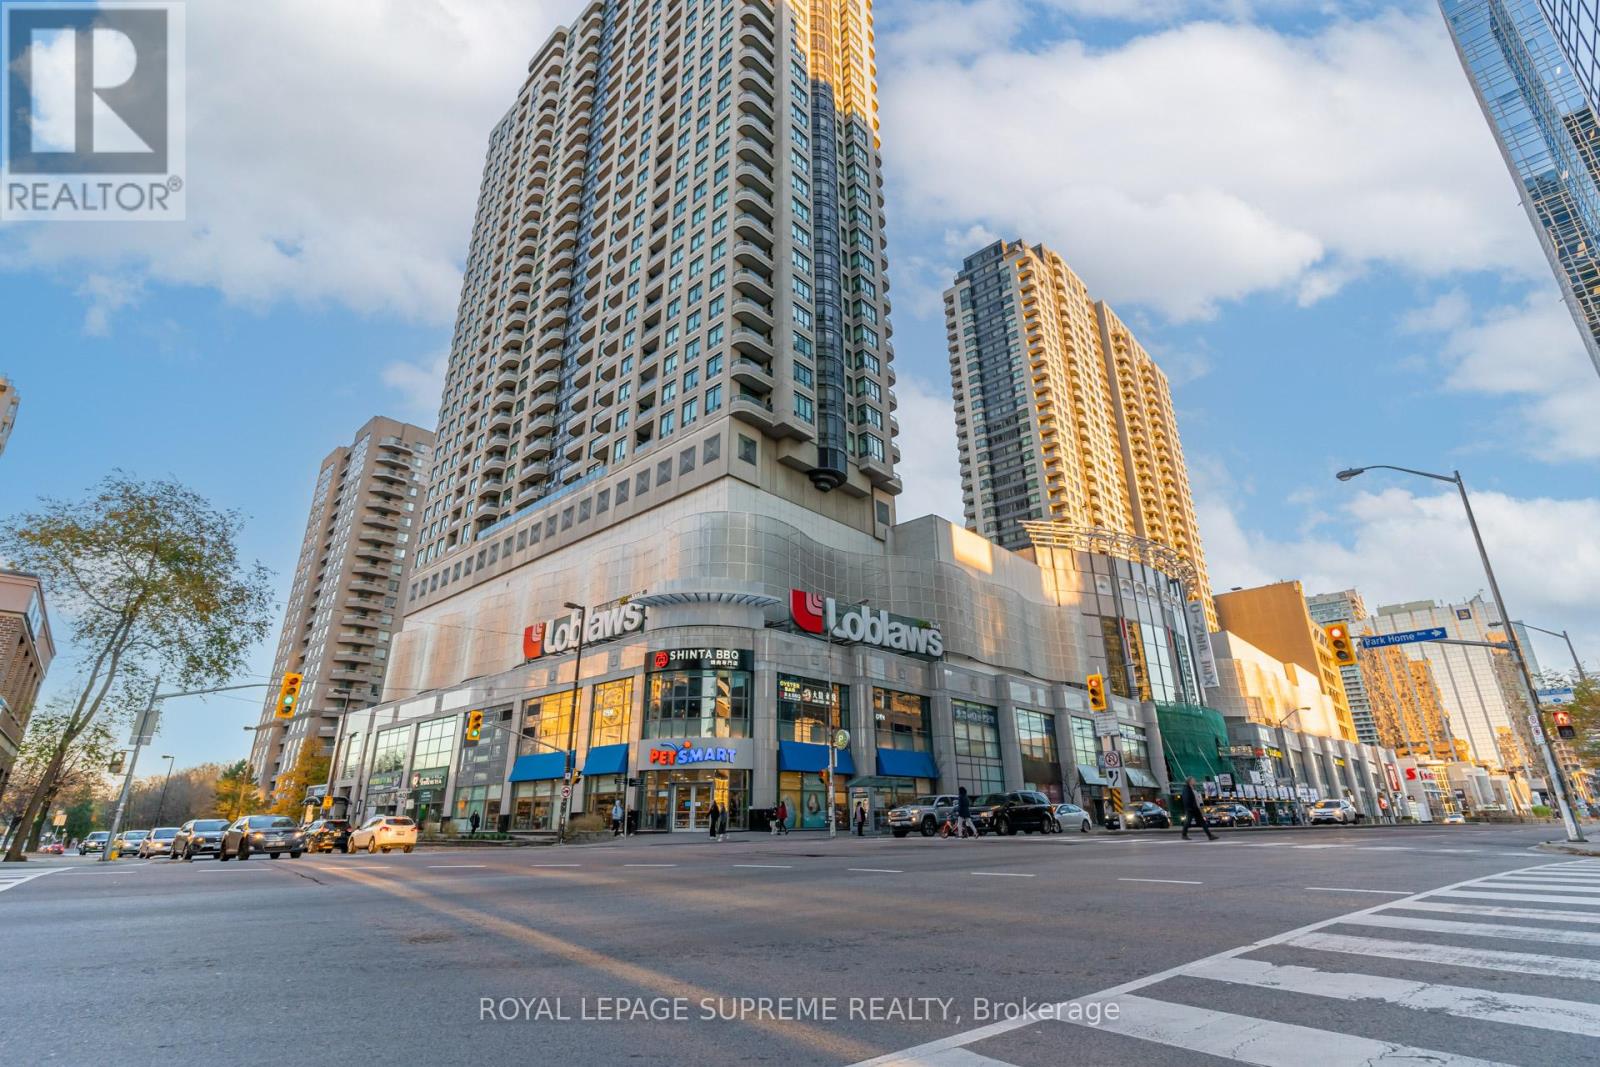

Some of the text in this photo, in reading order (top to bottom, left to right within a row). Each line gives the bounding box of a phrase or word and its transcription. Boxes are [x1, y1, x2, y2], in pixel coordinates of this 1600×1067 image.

[543, 602, 645, 654] Loblaws
[826, 597, 944, 657] Loblaws
[1365, 637, 1386, 647] Park
[1387, 633, 1415, 644] Home
[670, 649, 739, 660] SHINTA BBQ
[780, 680, 800, 689] OYSTER
